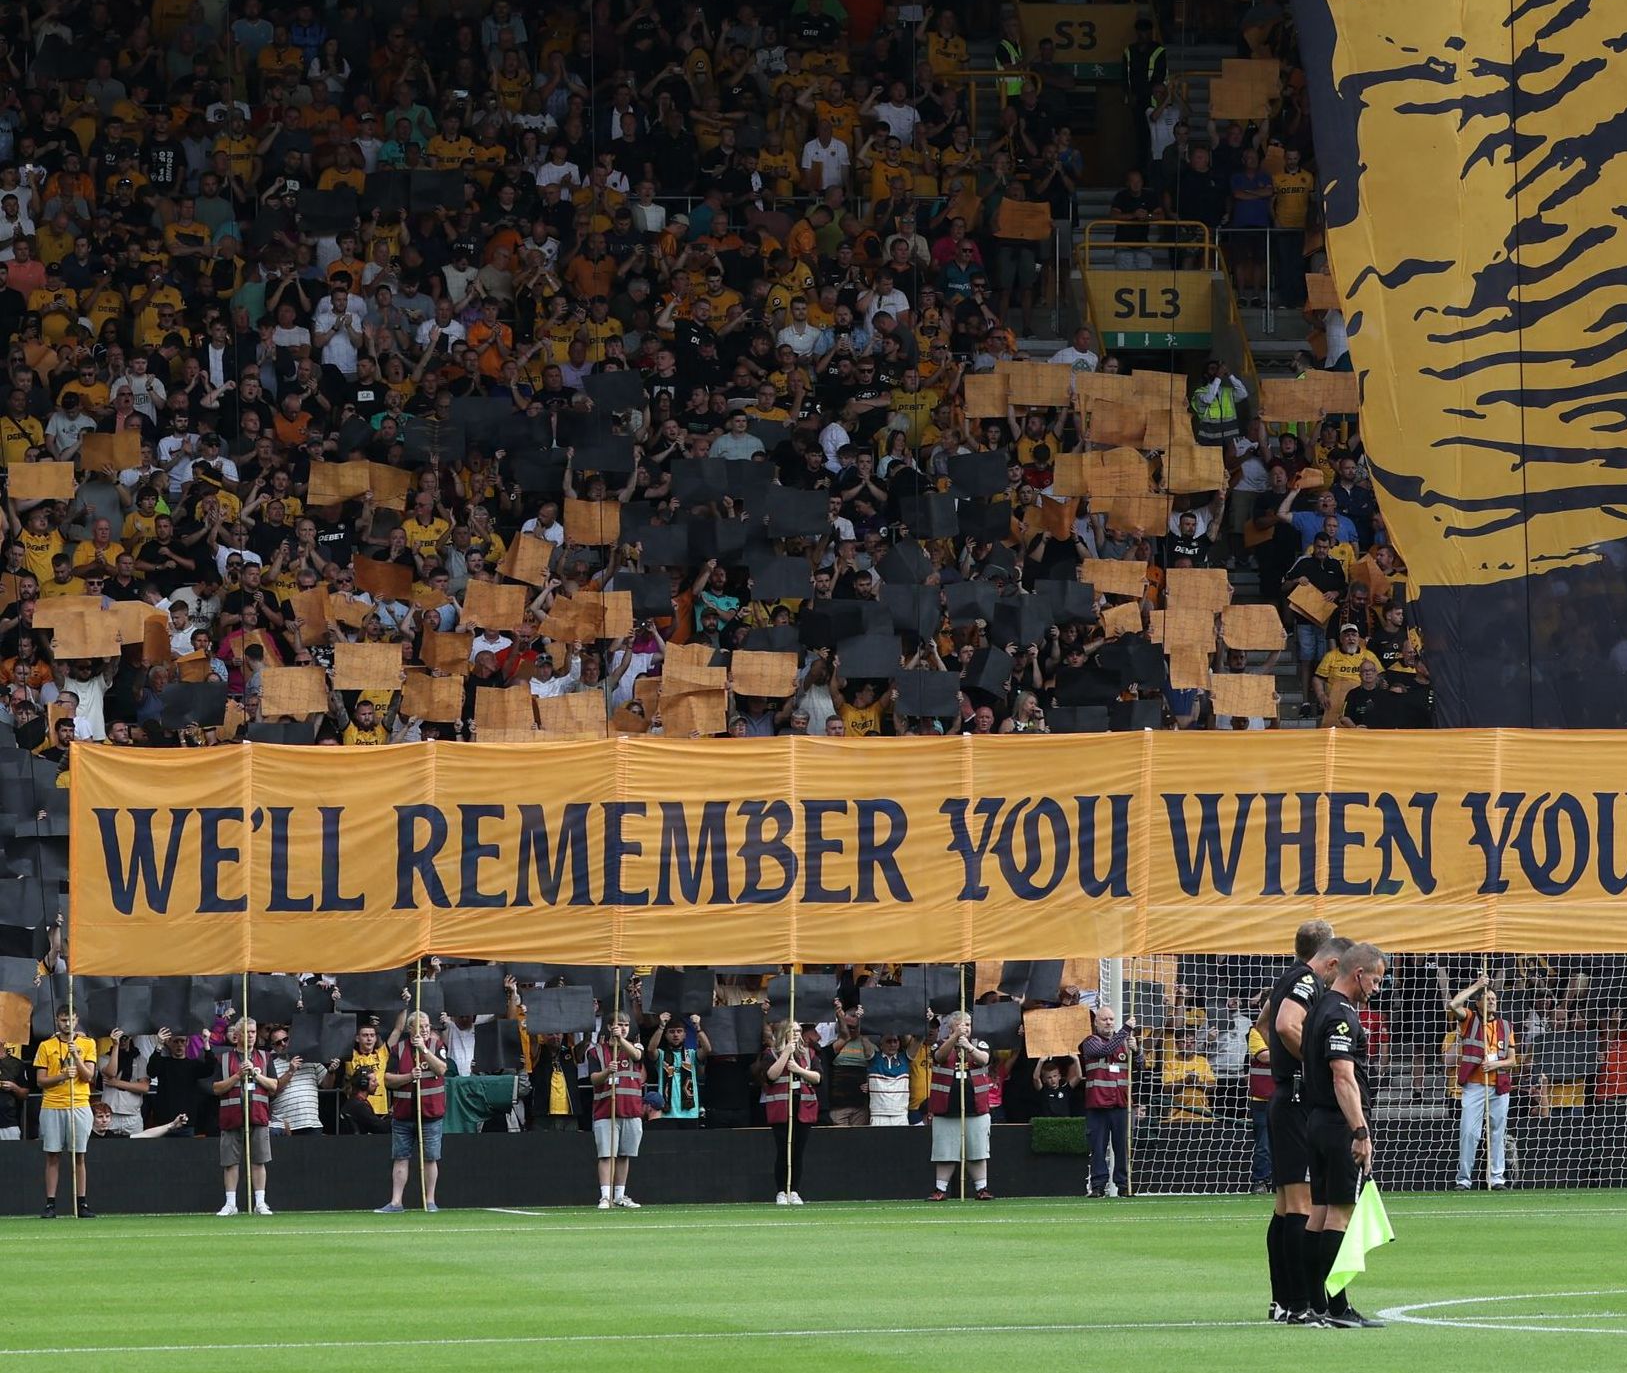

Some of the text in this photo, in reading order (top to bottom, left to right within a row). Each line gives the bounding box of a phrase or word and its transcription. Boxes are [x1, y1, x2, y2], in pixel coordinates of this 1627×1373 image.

[1055, 21, 1097, 50] S3
[1114, 288, 1180, 319] SL3
[317, 532, 346, 543] DEBET
[25, 541, 50, 552] DEBET
[1174, 545, 1200, 556] DEBET
[851, 719, 874, 730] DEBET
[95, 804, 364, 914] WE'LL
[395, 799, 910, 908] REMEMBER
[940, 795, 1130, 900] YOU
[1163, 793, 1437, 896] WHEN
